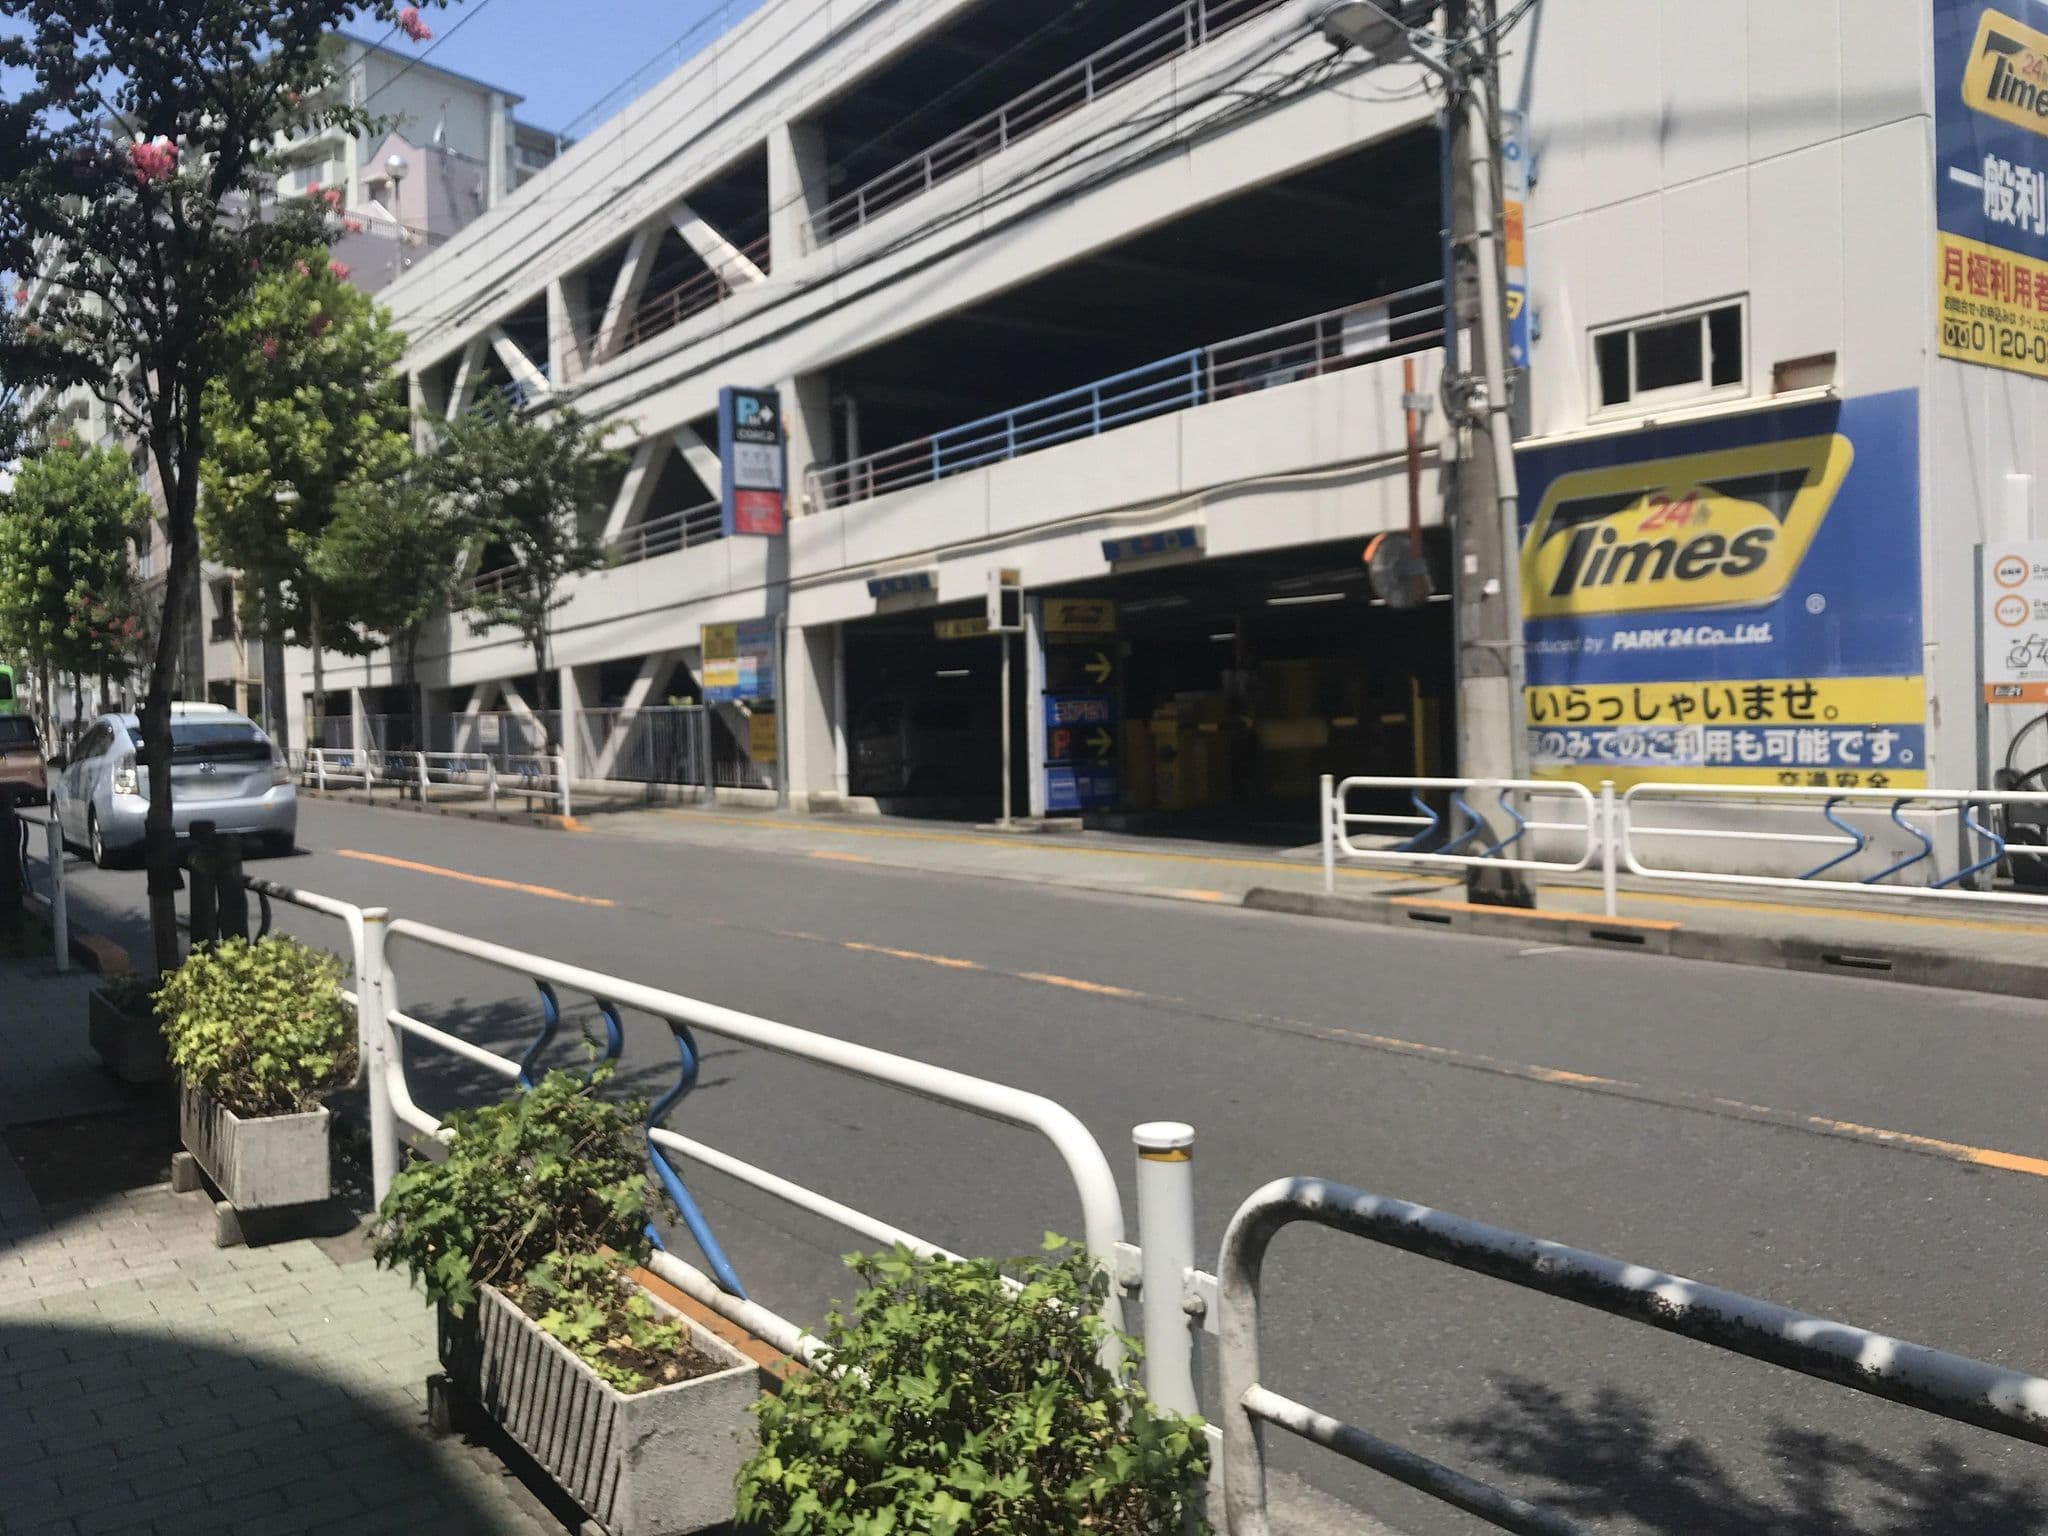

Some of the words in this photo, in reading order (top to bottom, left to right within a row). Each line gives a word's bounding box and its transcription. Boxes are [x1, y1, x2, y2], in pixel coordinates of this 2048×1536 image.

[1949, 153, 2048, 236] 一般利
[1972, 320, 2048, 364] 0120-0
[1540, 486, 1790, 597] Times
[1530, 682, 1839, 722] いらっしゃいませ。
